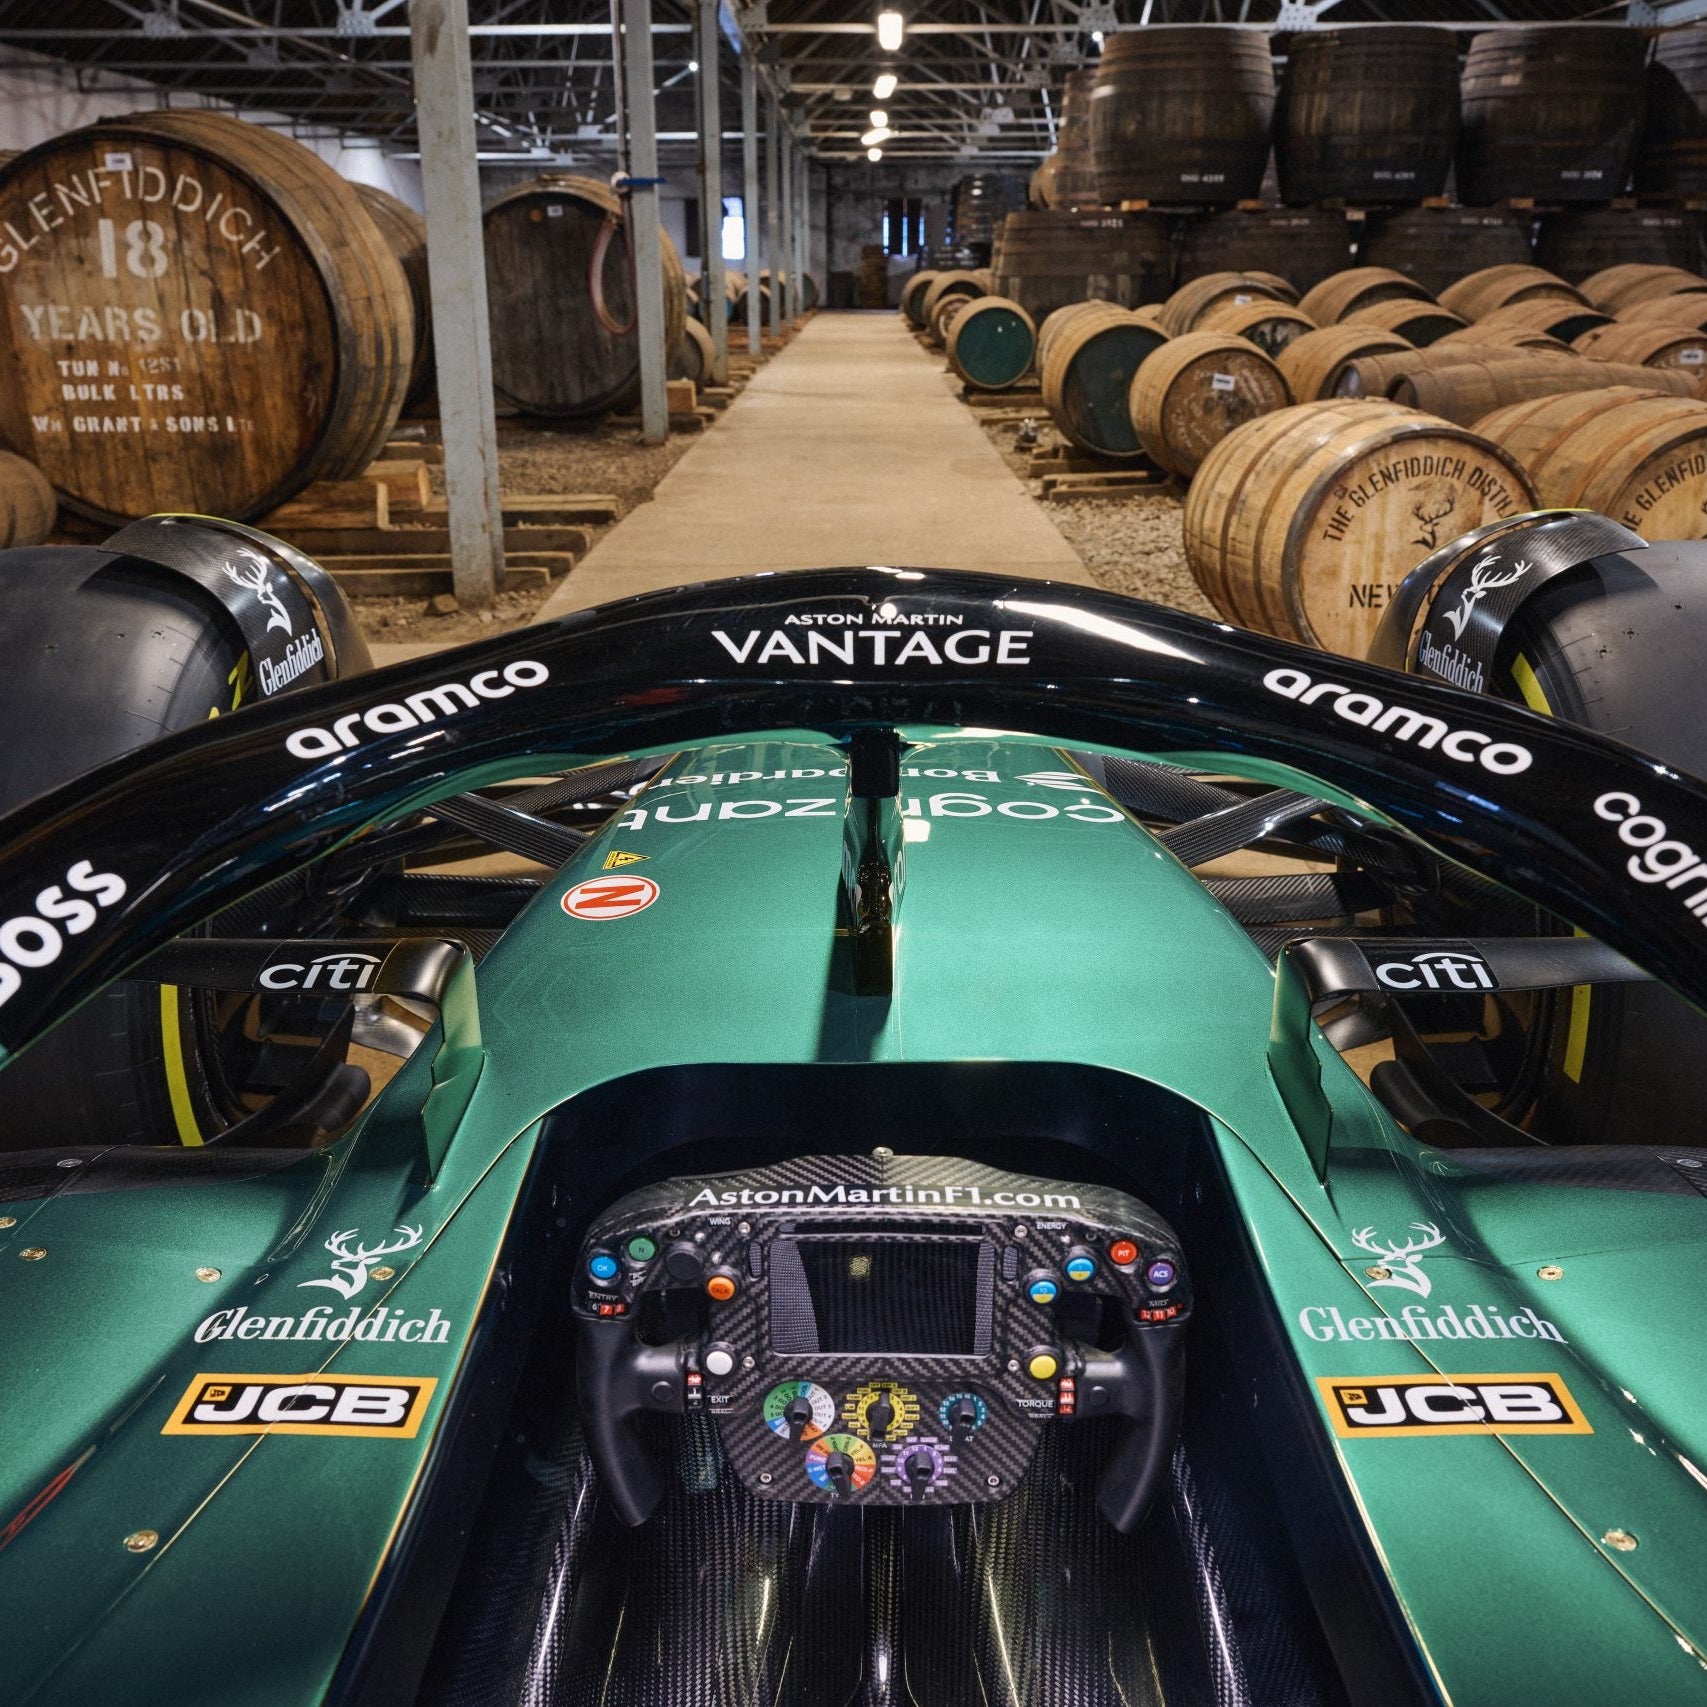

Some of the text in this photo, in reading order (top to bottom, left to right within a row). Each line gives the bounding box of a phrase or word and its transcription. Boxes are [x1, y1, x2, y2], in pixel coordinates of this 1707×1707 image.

[0, 164, 281, 273] GLENFIDDICH
[98, 218, 168, 279] 18
[20, 303, 263, 343] YEARS OLD
[57, 359, 99, 378] TUN
[61, 383, 185, 401] BULK LTRS
[72, 415, 142, 433] GRANT
[165, 415, 220, 433] SONS
[1323, 507, 1355, 543] THE
[1348, 455, 1466, 508] GLENFIDDICH
[783, 613, 965, 627] ASTON MARTIN
[258, 628, 325, 698] Glenfiddich
[710, 629, 1035, 666] VANTAGE
[1419, 629, 1485, 695] Glenfiddich
[285, 659, 551, 760] aramco
[1262, 668, 1534, 776] aramco
[258, 952, 383, 991] citi
[1376, 952, 1495, 990] citi
[688, 1184, 1082, 1211] AstonMartinF1.com
[709, 1217, 732, 1226] WING
[1036, 1221, 1068, 1231] ENERGY
[596, 1264, 608, 1272] OK
[1117, 1249, 1130, 1257] PIT
[1153, 1270, 1169, 1278] ACS
[193, 1306, 451, 1344] Glenfiddich
[1298, 1304, 1569, 1344] Glenfiddich
[193, 1385, 410, 1424] JCB
[709, 1395, 730, 1404] EXIT
[1016, 1399, 1054, 1408] TORQUE
[1346, 1385, 1563, 1425] JCB
